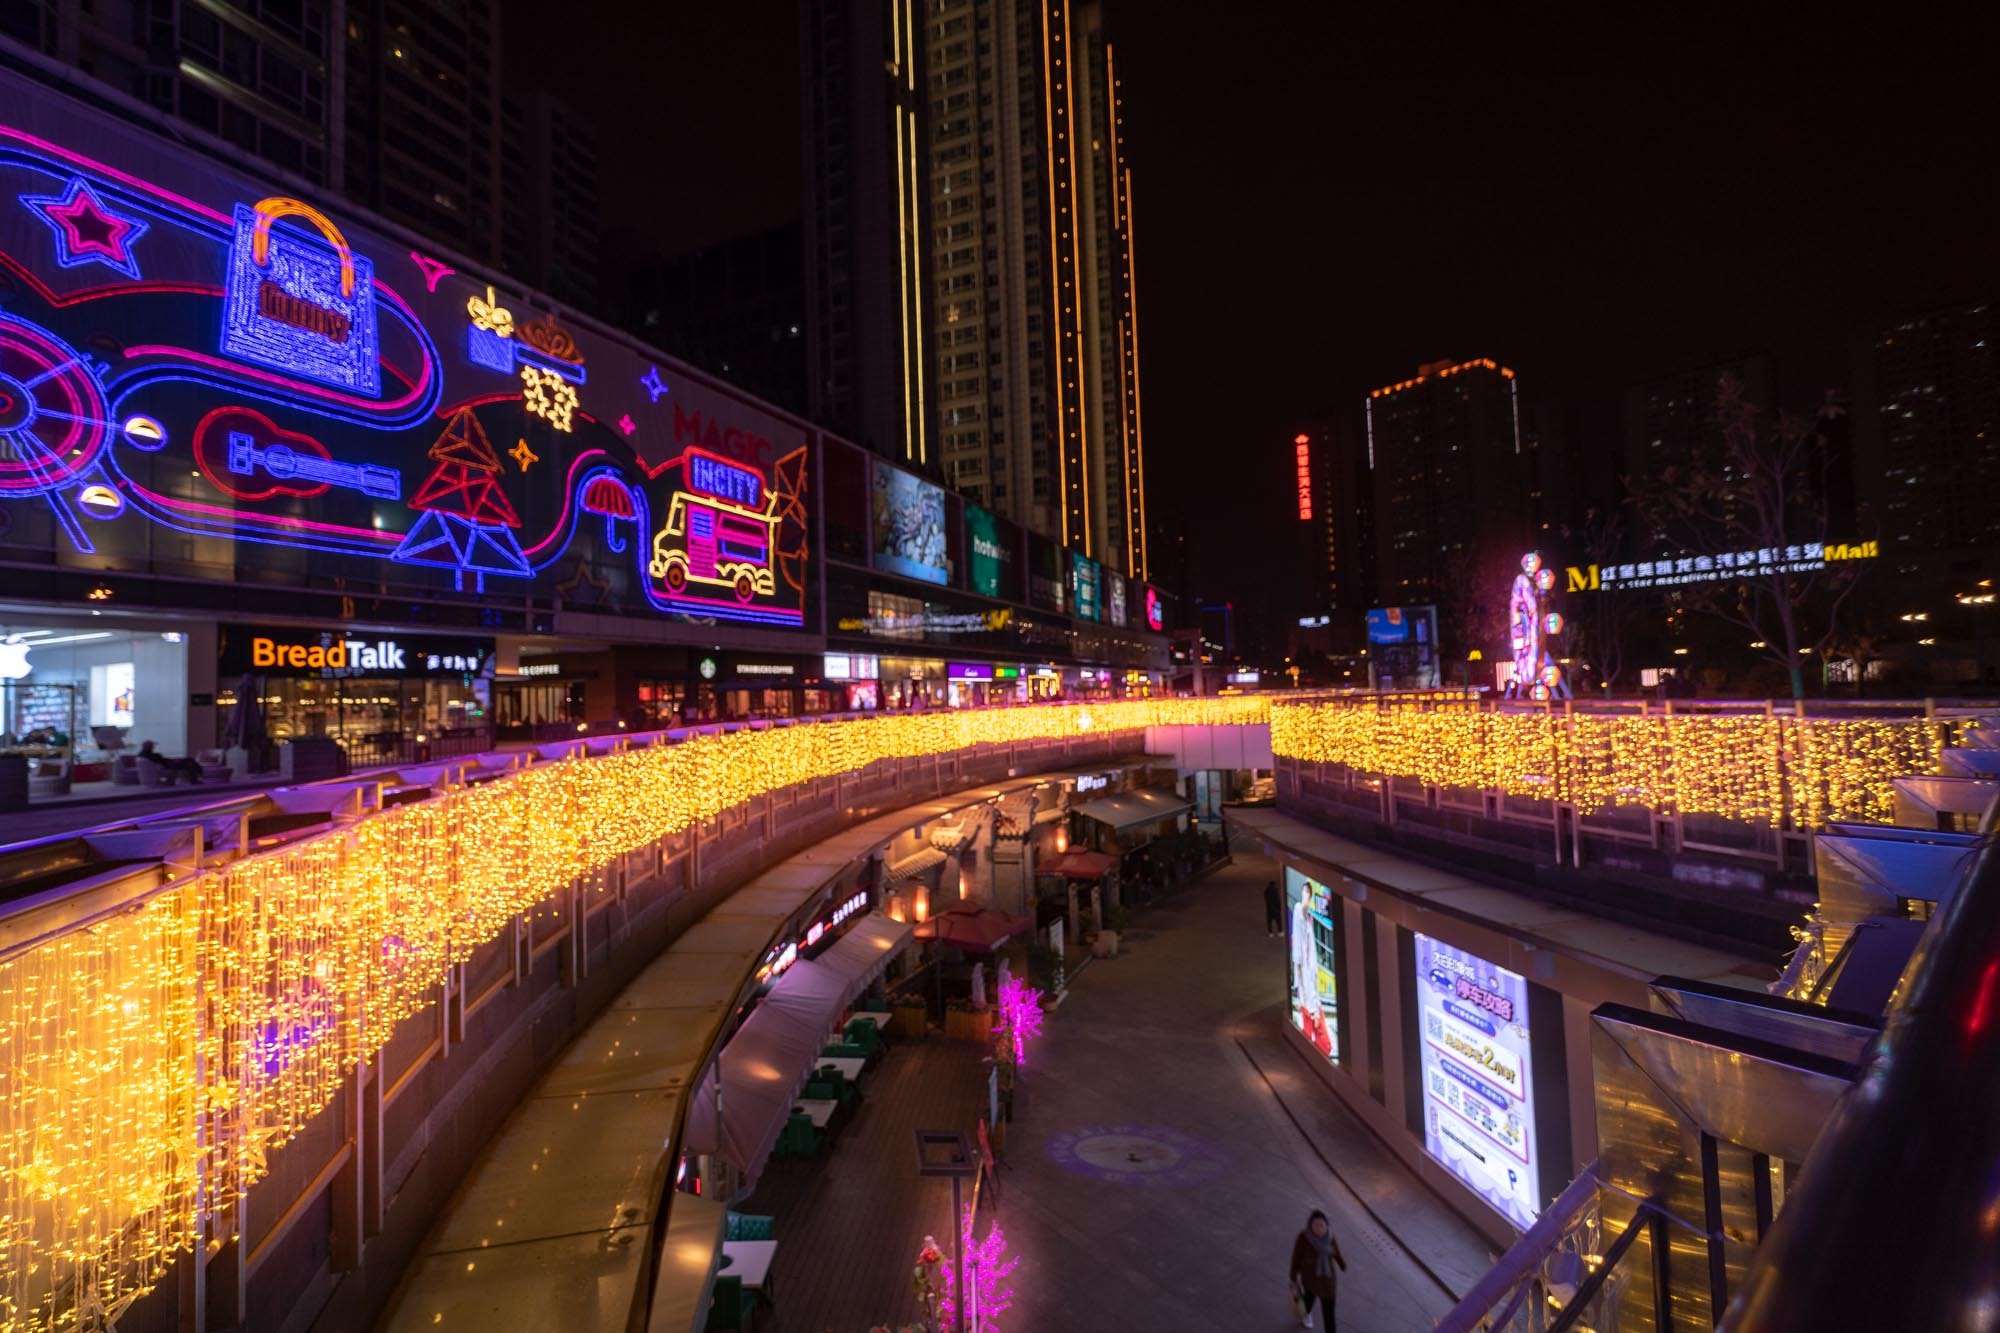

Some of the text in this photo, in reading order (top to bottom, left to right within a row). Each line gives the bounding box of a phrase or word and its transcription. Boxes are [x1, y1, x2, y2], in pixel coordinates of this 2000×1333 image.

[673, 400, 774, 472] MAGIC
[692, 456, 760, 507] INCITY
[253, 637, 406, 669] BreadTalk
[1456, 977, 1513, 1022] 停车攻略
